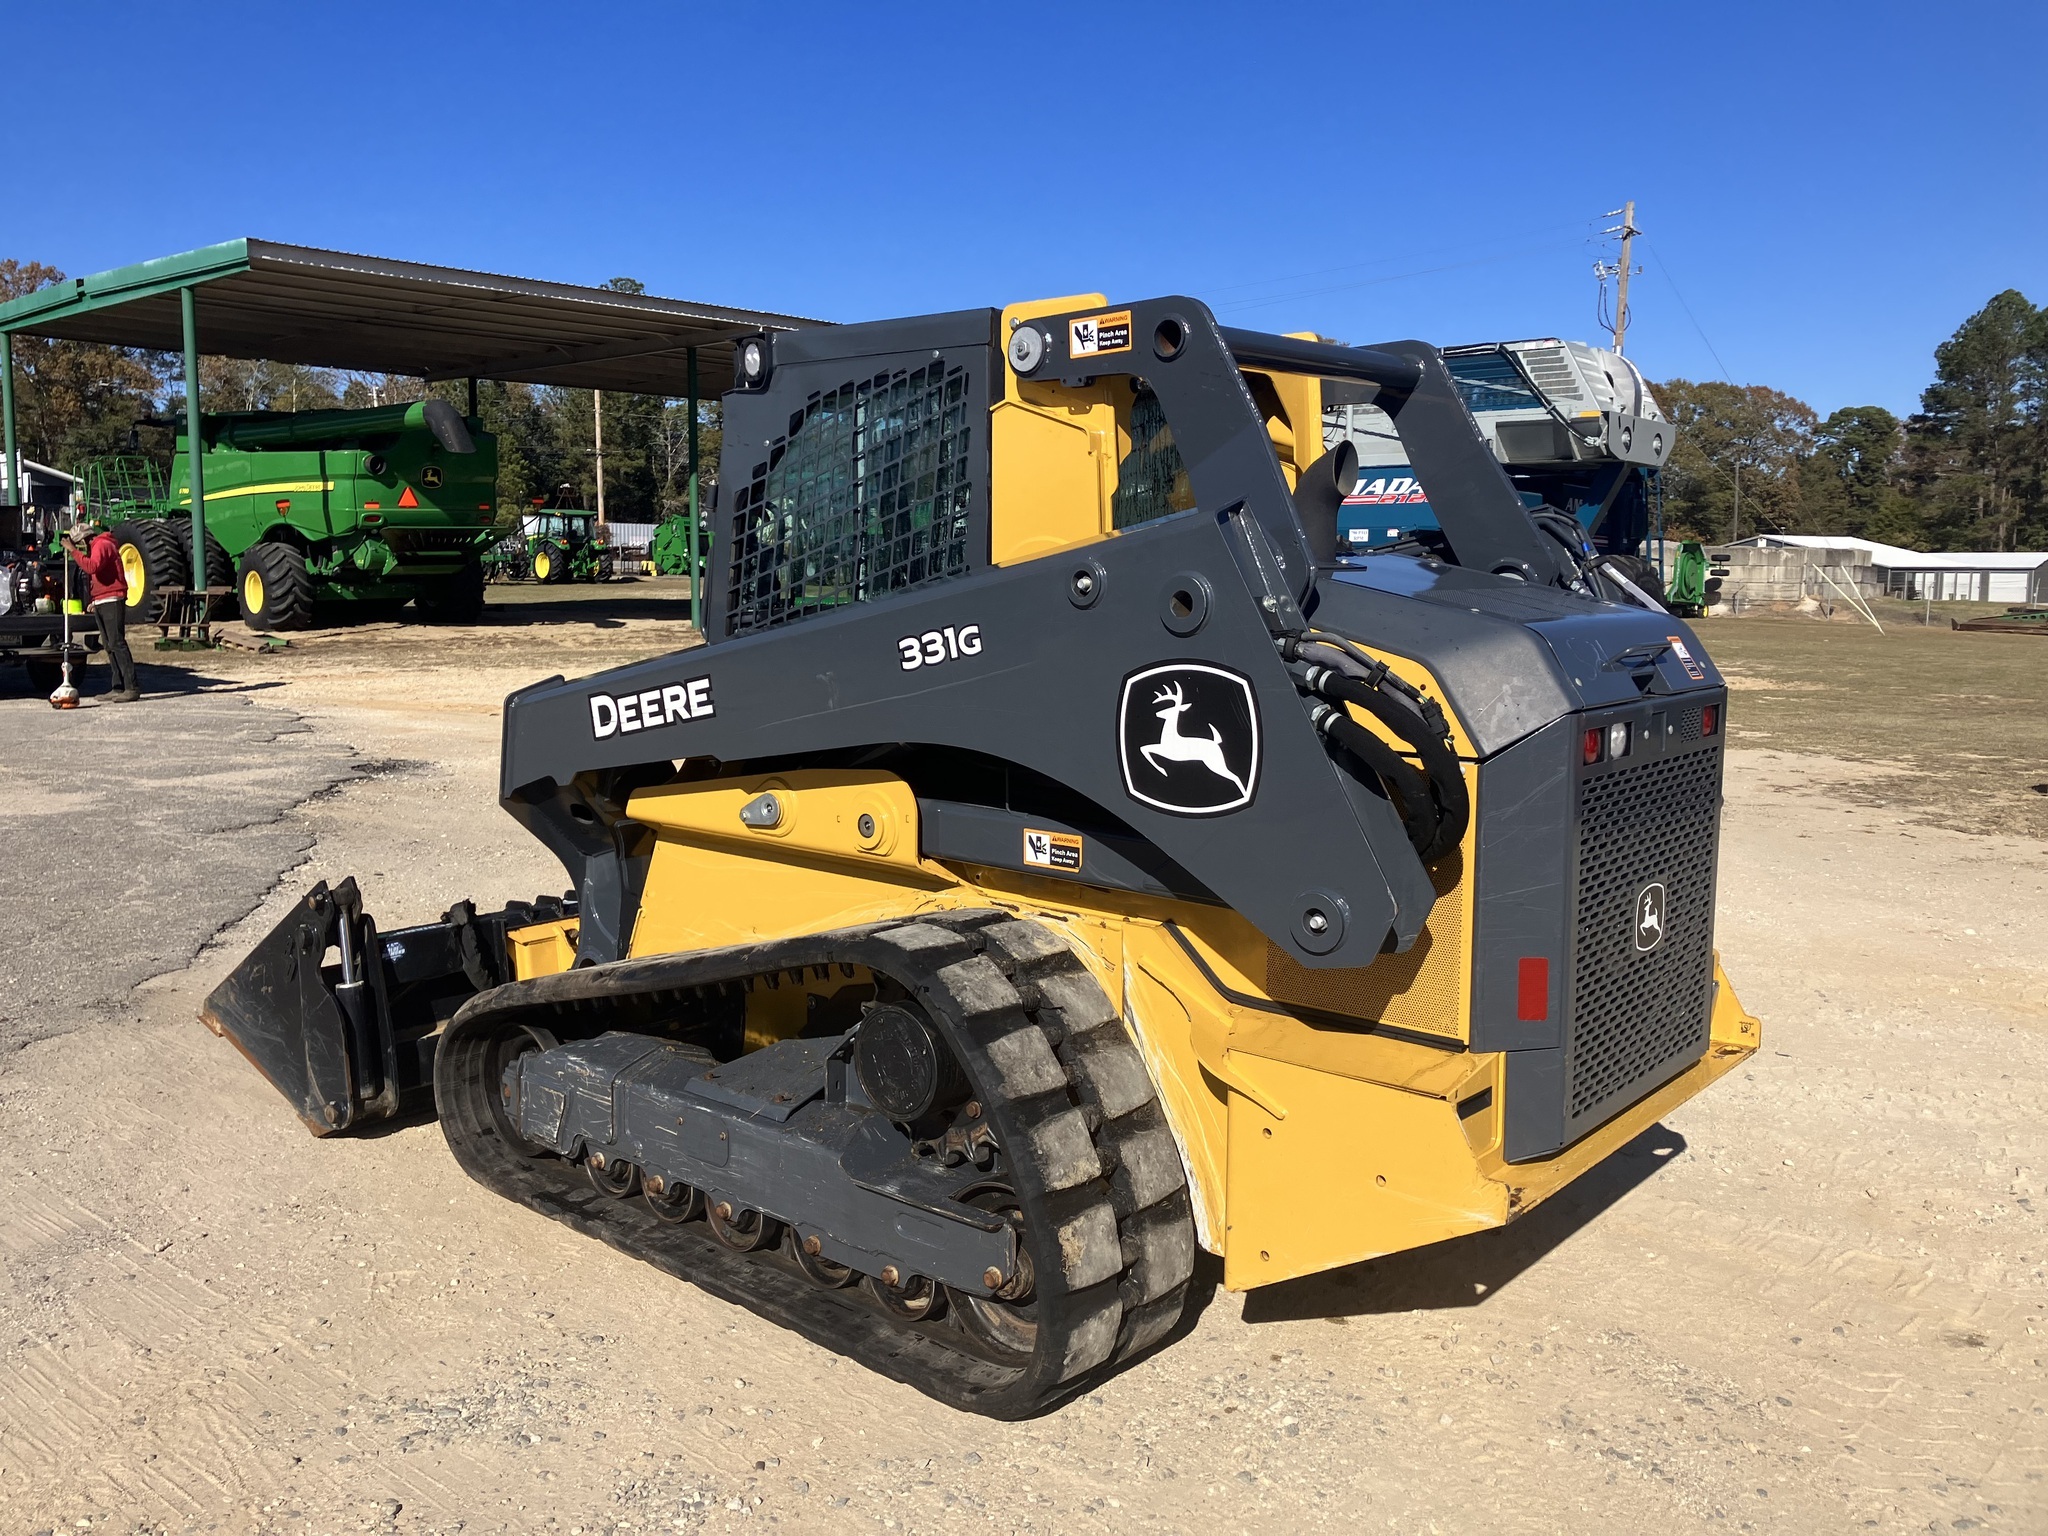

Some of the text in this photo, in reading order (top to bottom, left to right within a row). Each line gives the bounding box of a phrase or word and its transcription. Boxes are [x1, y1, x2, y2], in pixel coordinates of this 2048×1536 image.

[1099, 331, 1114, 339] Pinch
[1378, 493, 1429, 504] 212
[898, 625, 982, 670] 331G
[590, 678, 714, 738] DEERE
[1051, 848, 1078, 858] Pinch Area
